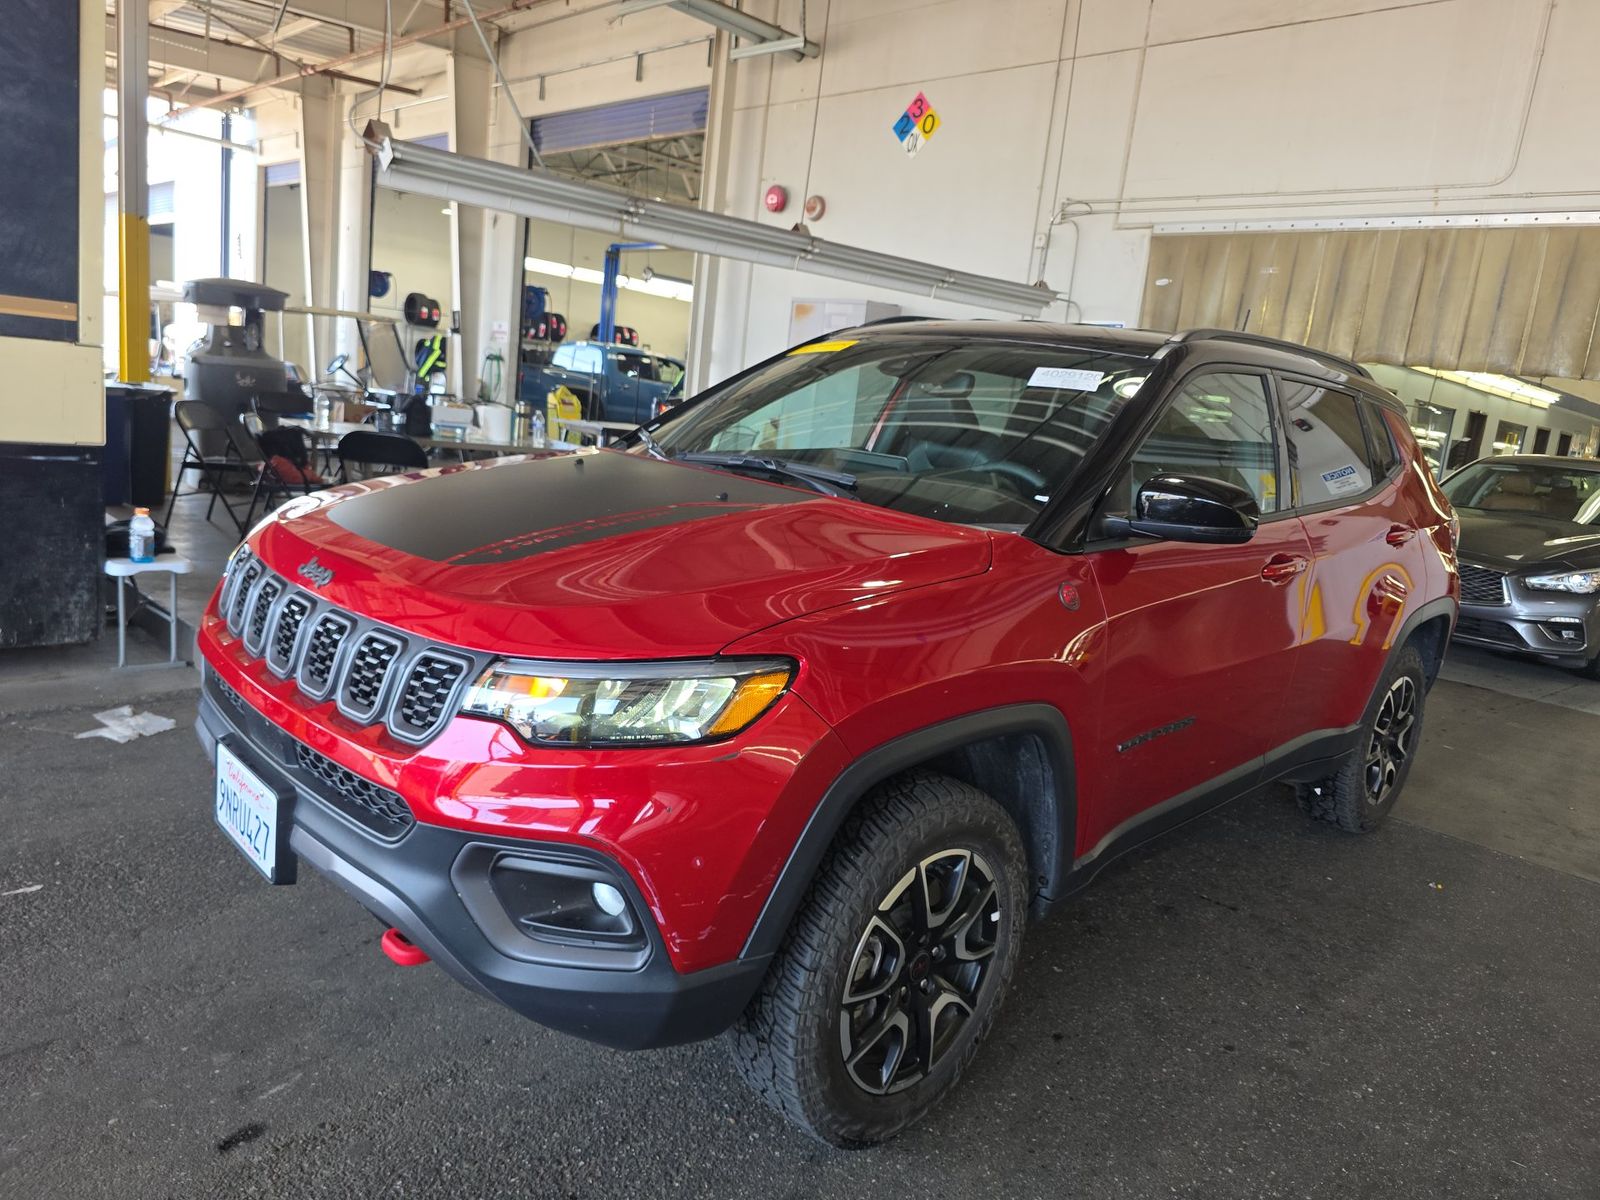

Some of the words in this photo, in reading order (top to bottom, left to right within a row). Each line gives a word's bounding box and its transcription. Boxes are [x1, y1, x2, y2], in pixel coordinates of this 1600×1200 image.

[912, 98, 924, 118] 3
[899, 114, 911, 135] 2
[922, 113, 935, 134] 0
[297, 556, 333, 589] Jeep
[219, 778, 270, 861] 9NRU427
